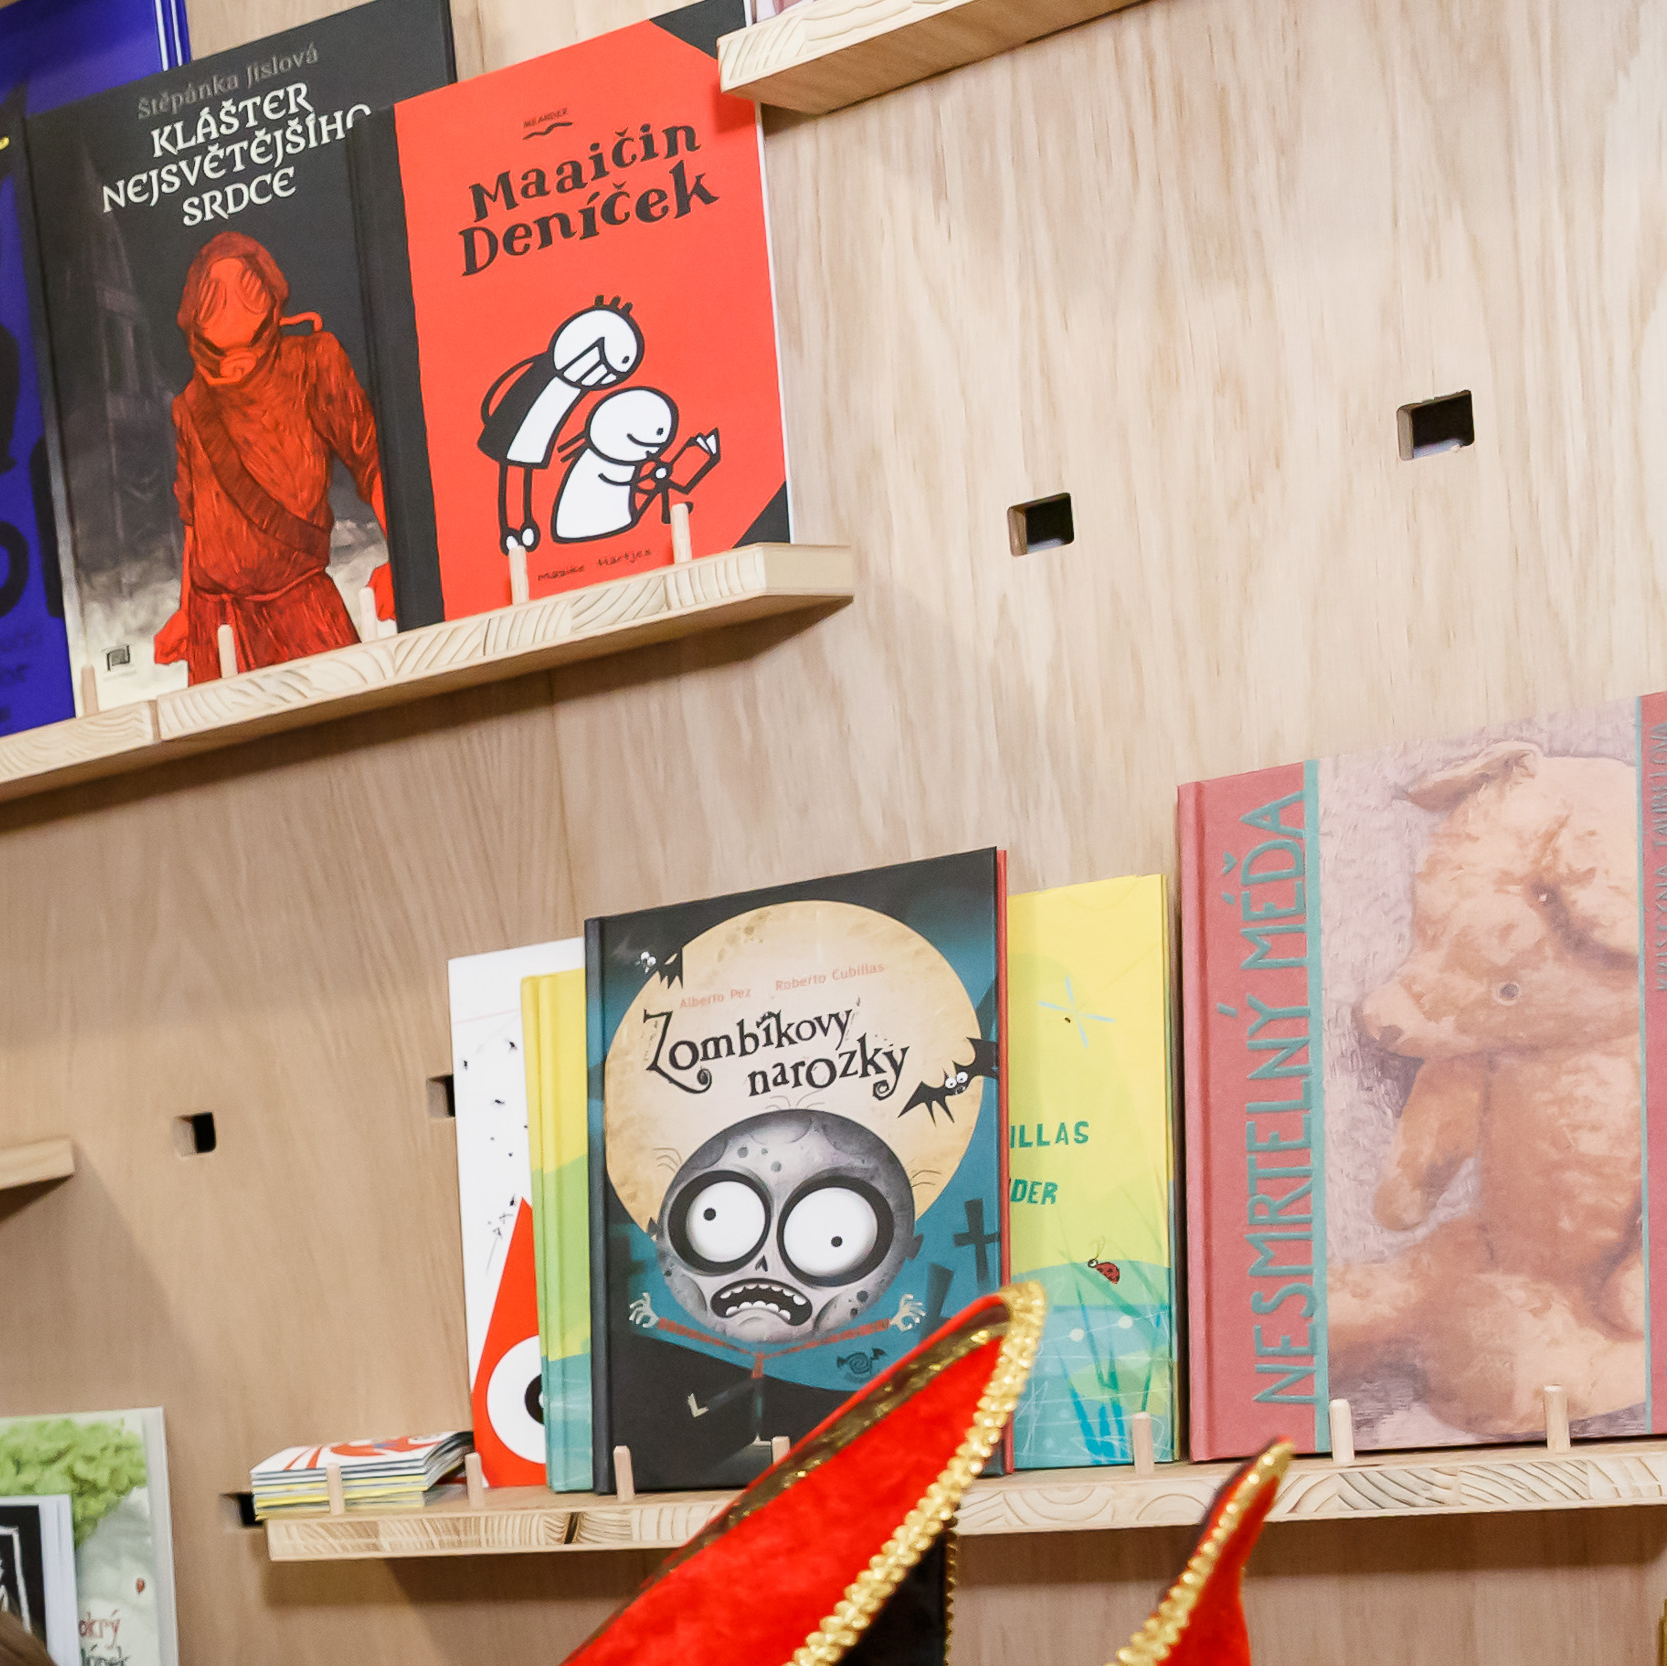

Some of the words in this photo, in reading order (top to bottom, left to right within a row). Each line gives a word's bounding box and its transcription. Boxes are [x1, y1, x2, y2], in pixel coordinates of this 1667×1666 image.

[150, 81, 315, 158] KLÁŠTER
[182, 166, 297, 227] SRDCE
[468, 123, 702, 223] Maaičin
[458, 159, 720, 277] Deníček
[679, 993, 725, 1010] Alberto
[774, 973, 827, 992] Roberto
[831, 962, 886, 981] Cubillas
[1218, 994, 1318, 1406] NESMRTELNÝ
